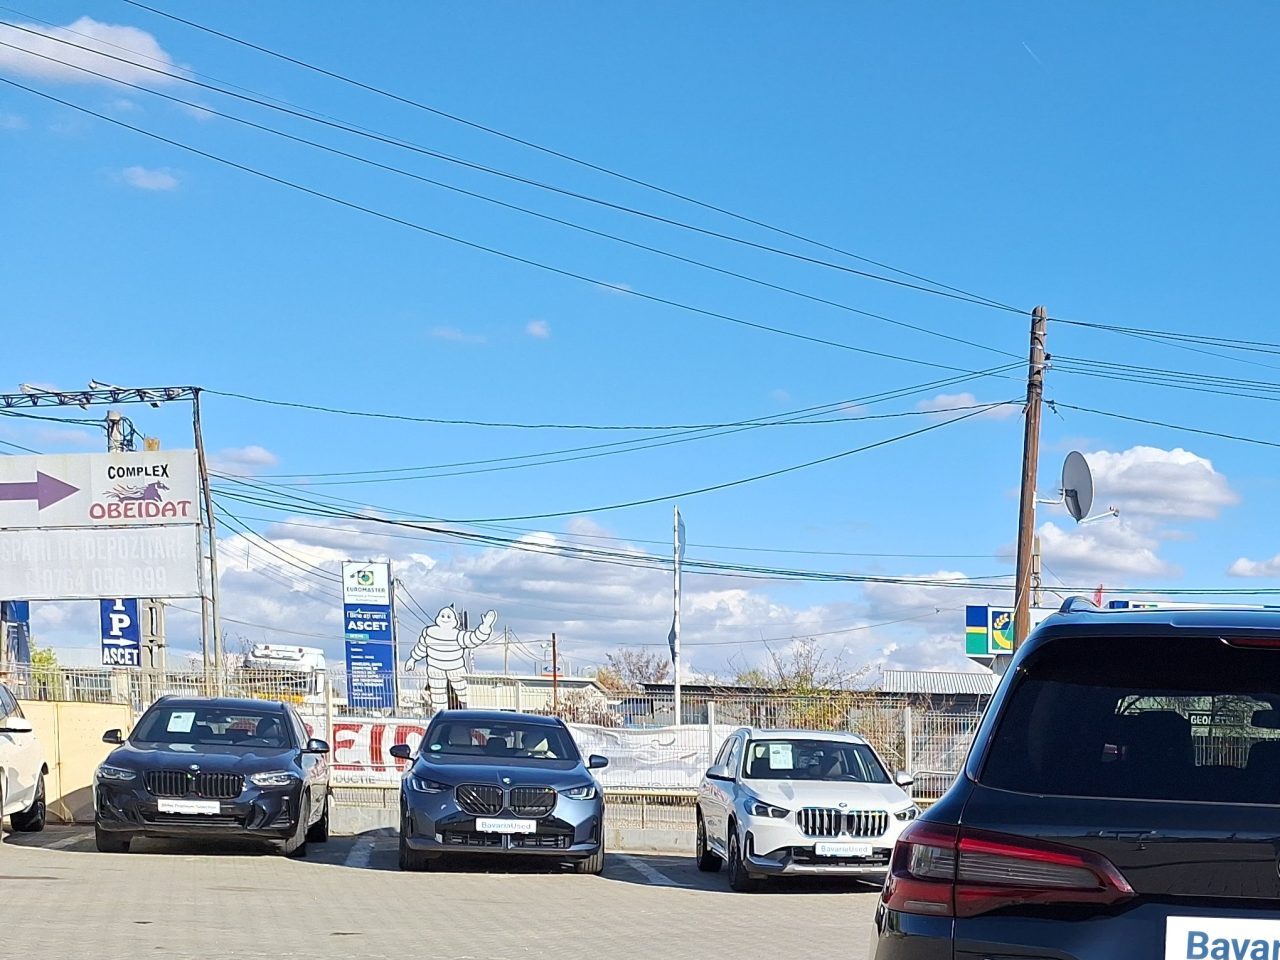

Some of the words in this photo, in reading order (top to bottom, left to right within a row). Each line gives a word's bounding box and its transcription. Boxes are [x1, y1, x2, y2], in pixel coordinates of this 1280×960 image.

[108, 464, 169, 479] COMPLEX
[89, 500, 192, 520] OBEIDAT
[348, 620, 389, 631] ASCET
[103, 647, 139, 665] ASCET
[481, 821, 531, 830] BavariaUsed
